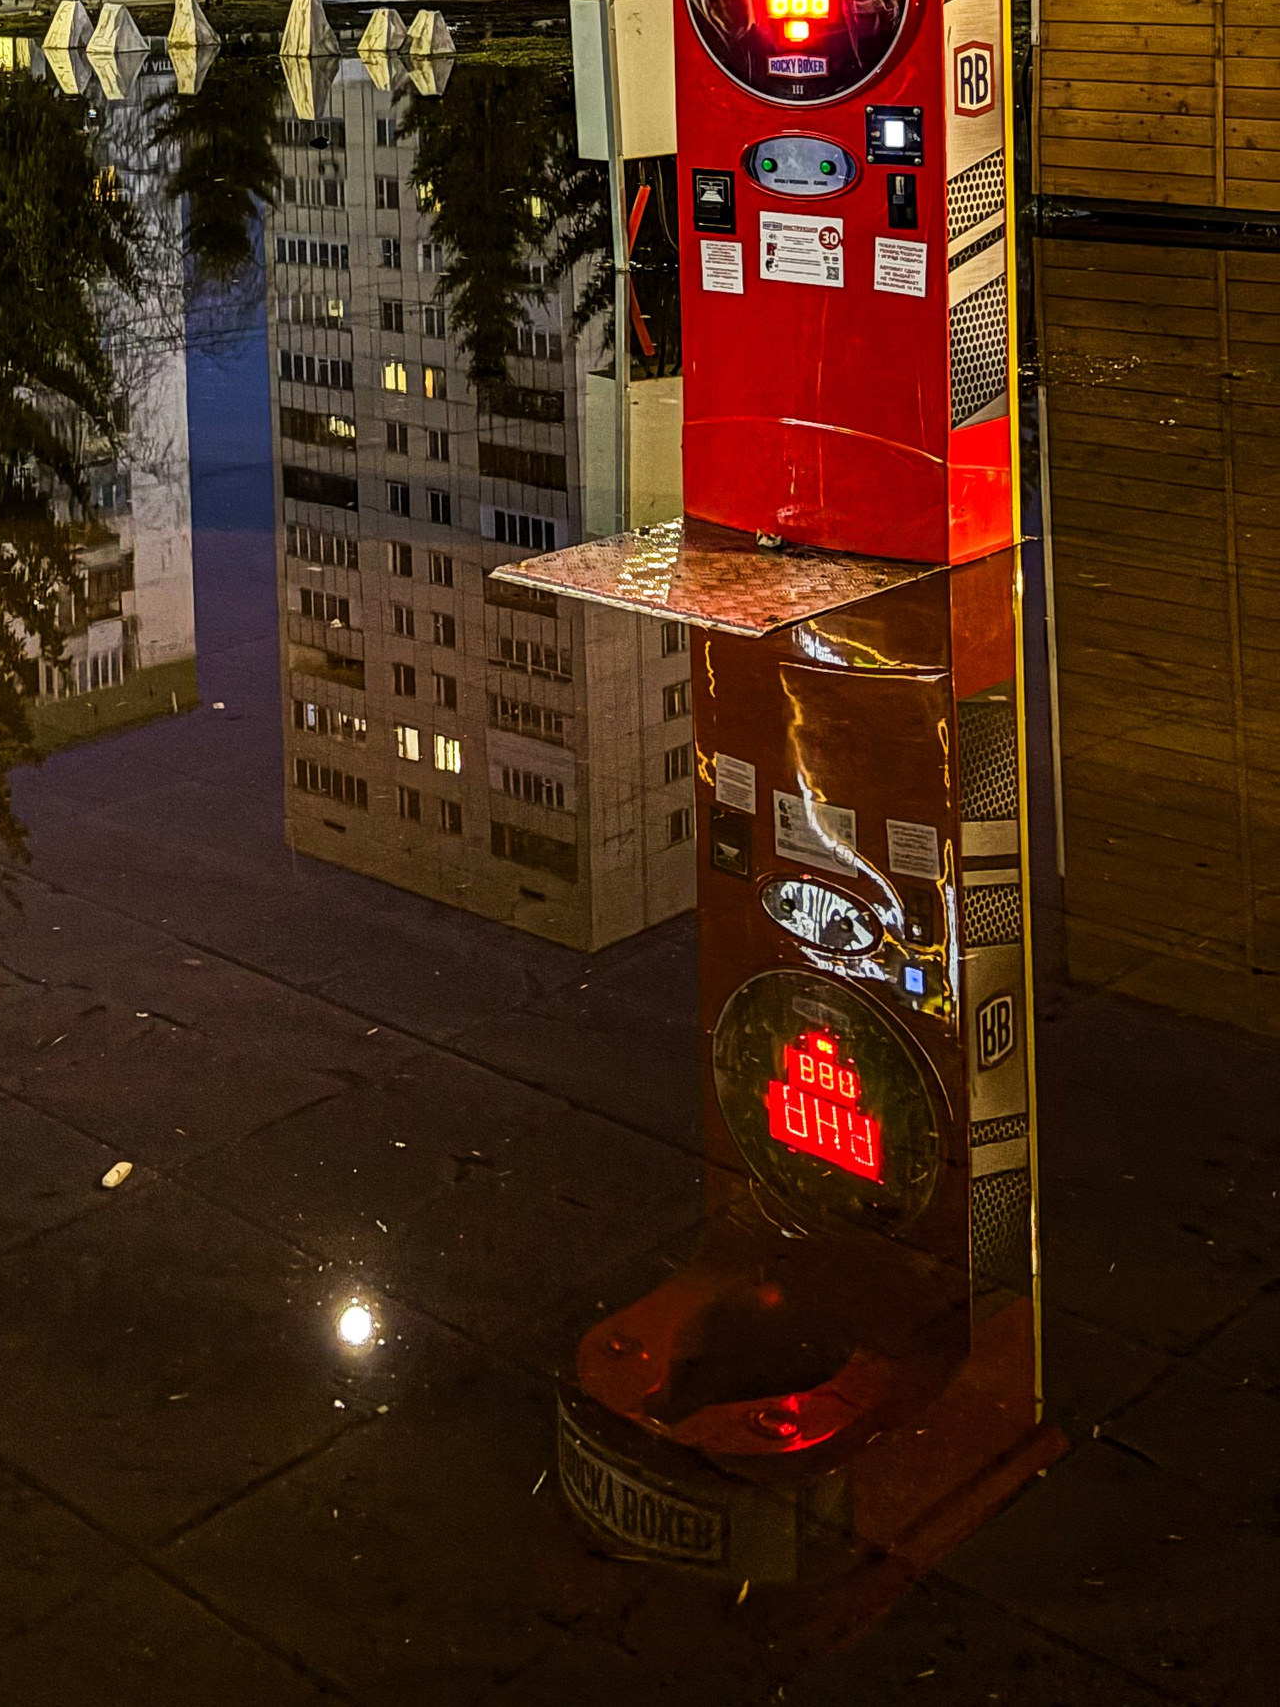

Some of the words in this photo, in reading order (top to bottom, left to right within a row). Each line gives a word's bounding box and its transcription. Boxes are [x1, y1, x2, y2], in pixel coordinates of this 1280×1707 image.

[770, 59, 796, 73] ROCKY
[797, 58, 824, 73] BOXER
[960, 52, 989, 105] RB
[821, 231, 839, 245] 30
